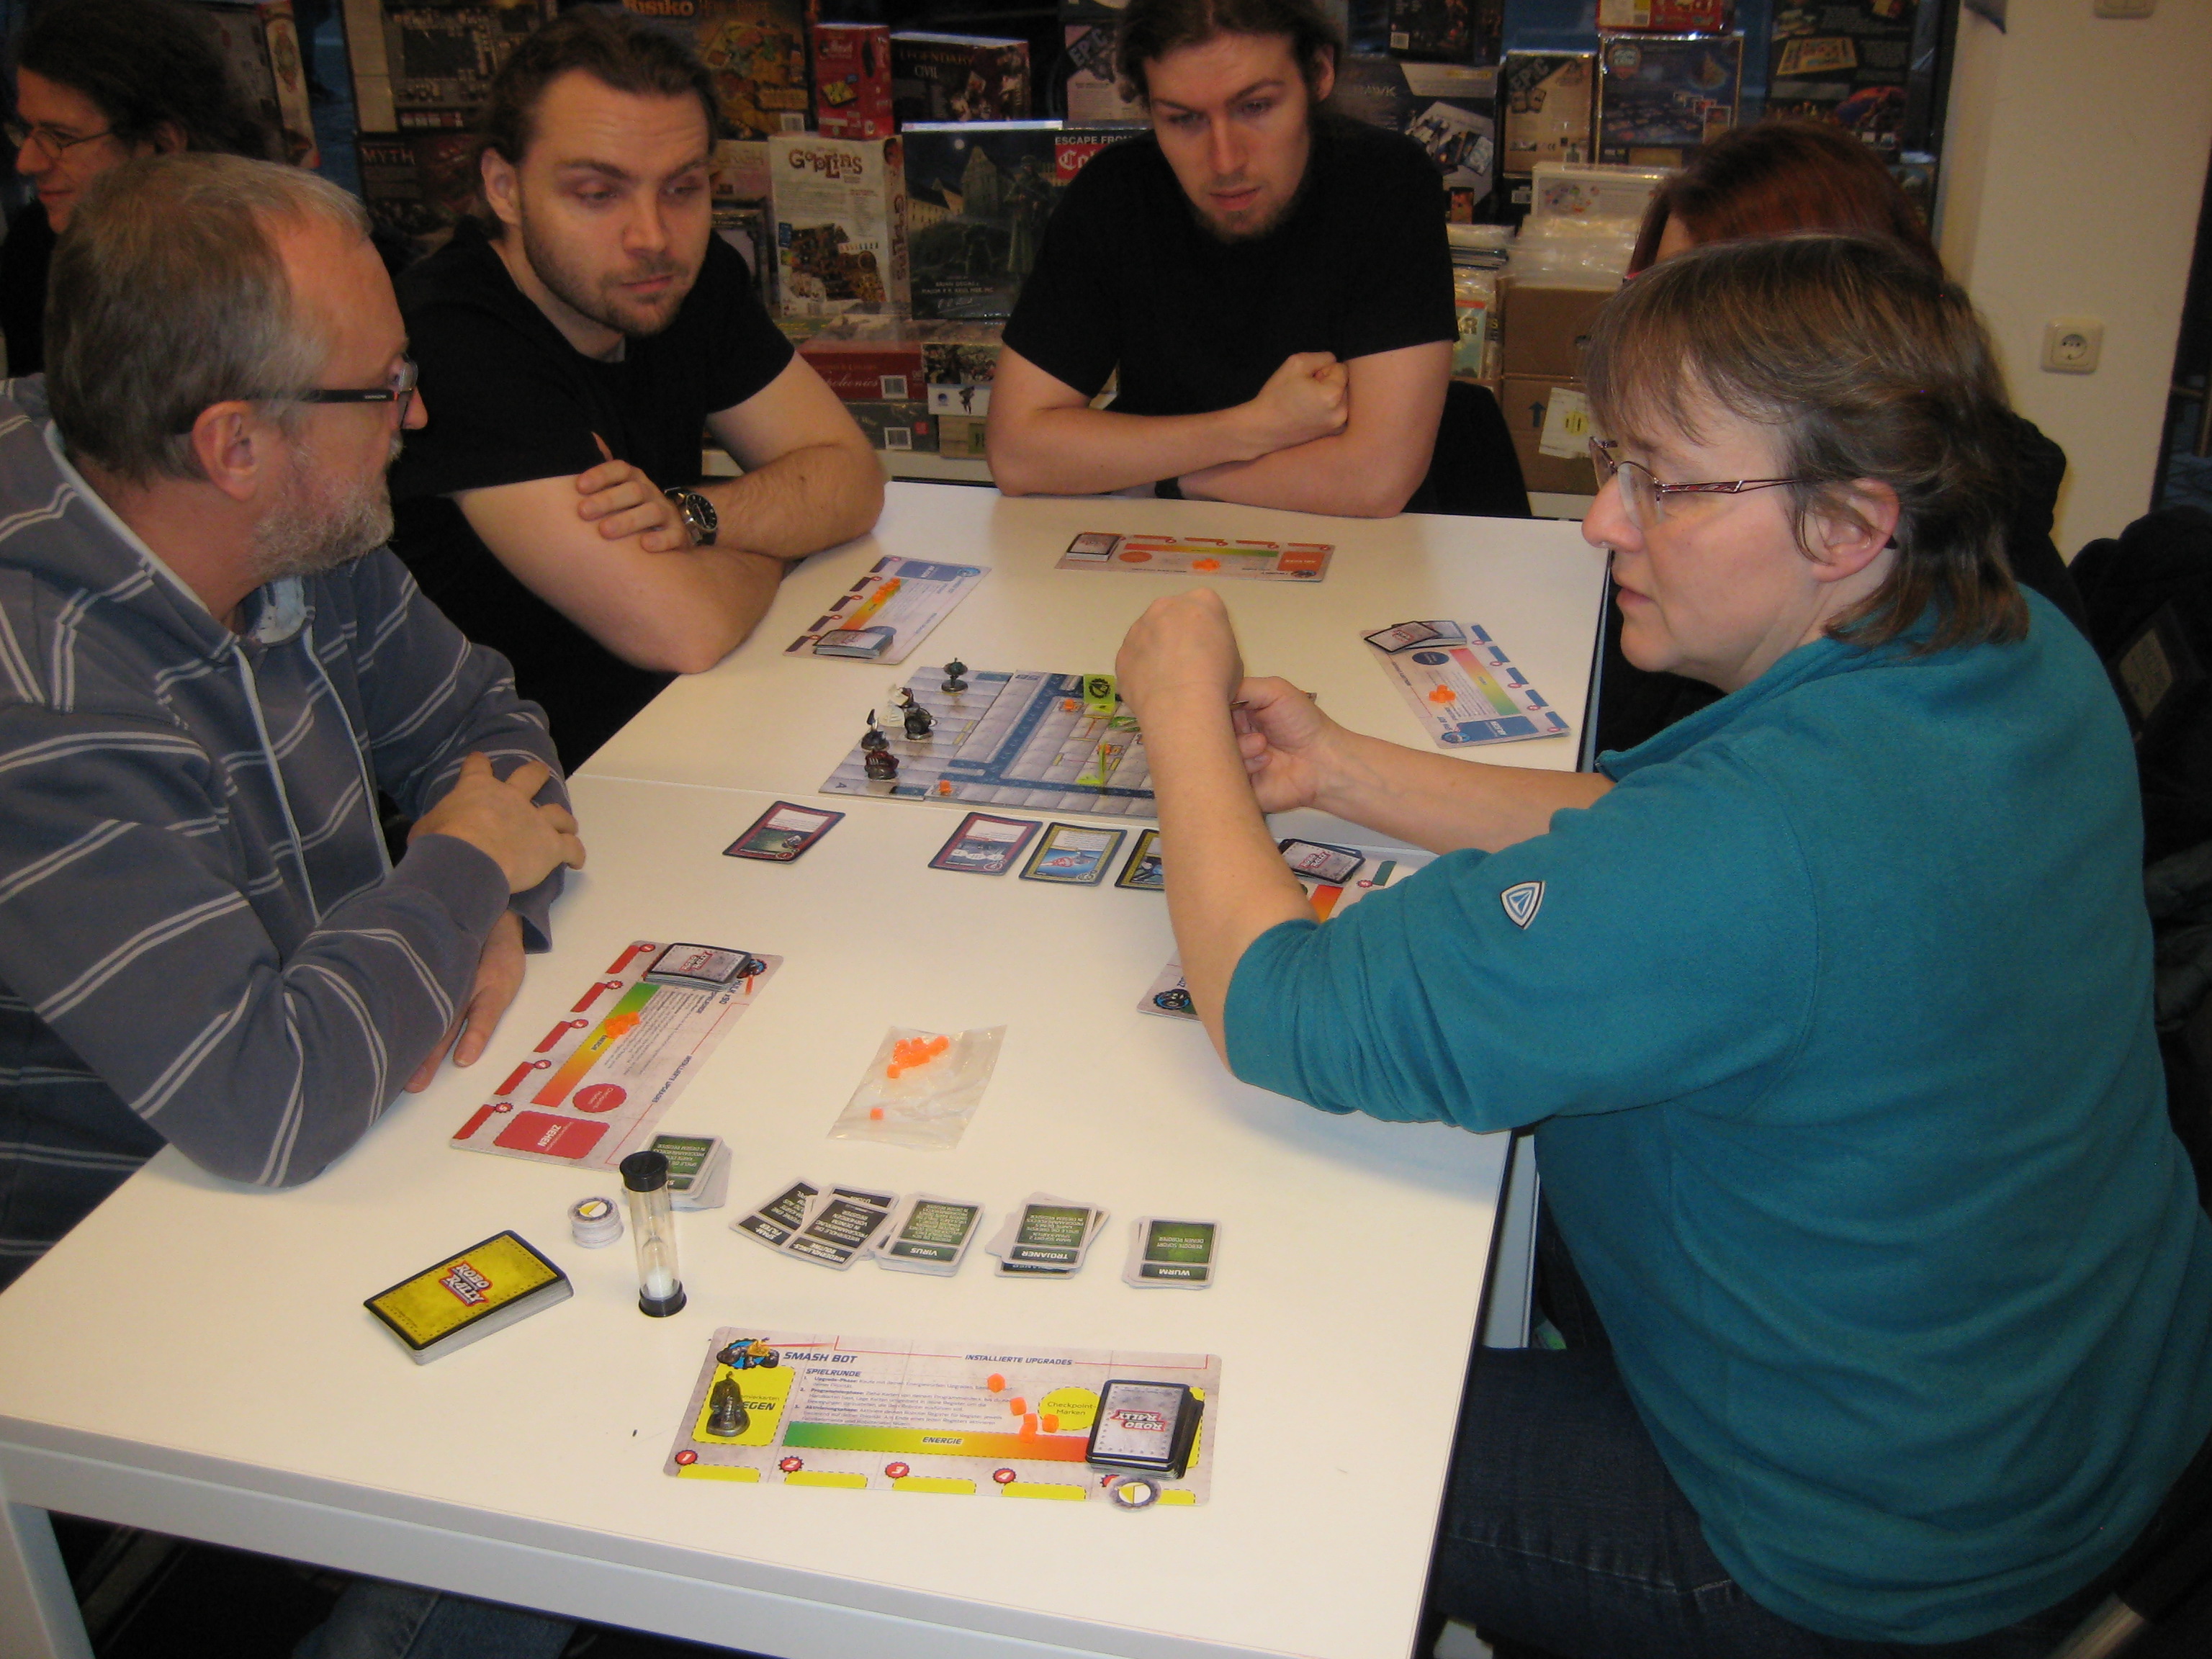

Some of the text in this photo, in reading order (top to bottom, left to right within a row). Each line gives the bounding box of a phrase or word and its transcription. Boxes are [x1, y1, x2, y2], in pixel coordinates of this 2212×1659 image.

[1054, 136, 1097, 145] ESCAPE
[361, 147, 415, 166] MYTH
[725, 979, 745, 993] HULK
[649, 1081, 673, 1103] UPGRADES
[534, 1124, 562, 1147] ZIEHEN
[758, 1223, 783, 1236] FILTER
[810, 1242, 837, 1254] ROUTINE
[909, 1247, 938, 1256] VIRUS
[1021, 1251, 1069, 1259] TROJANER
[454, 1264, 490, 1289] ROBO
[446, 1274, 485, 1304] RALLY
[782, 1351, 858, 1363] SMASH BOT
[964, 1354, 1073, 1365] INSTALLIERTE UPGRADES
[804, 1367, 862, 1377] SPIELRUNDE
[742, 1401, 776, 1411] EGEN
[1046, 1401, 1097, 1410] Checkpoint-
[1115, 1411, 1158, 1421] RALLY
[1124, 1421, 1164, 1431] ROBO
[921, 1436, 963, 1444] ENERGIE
